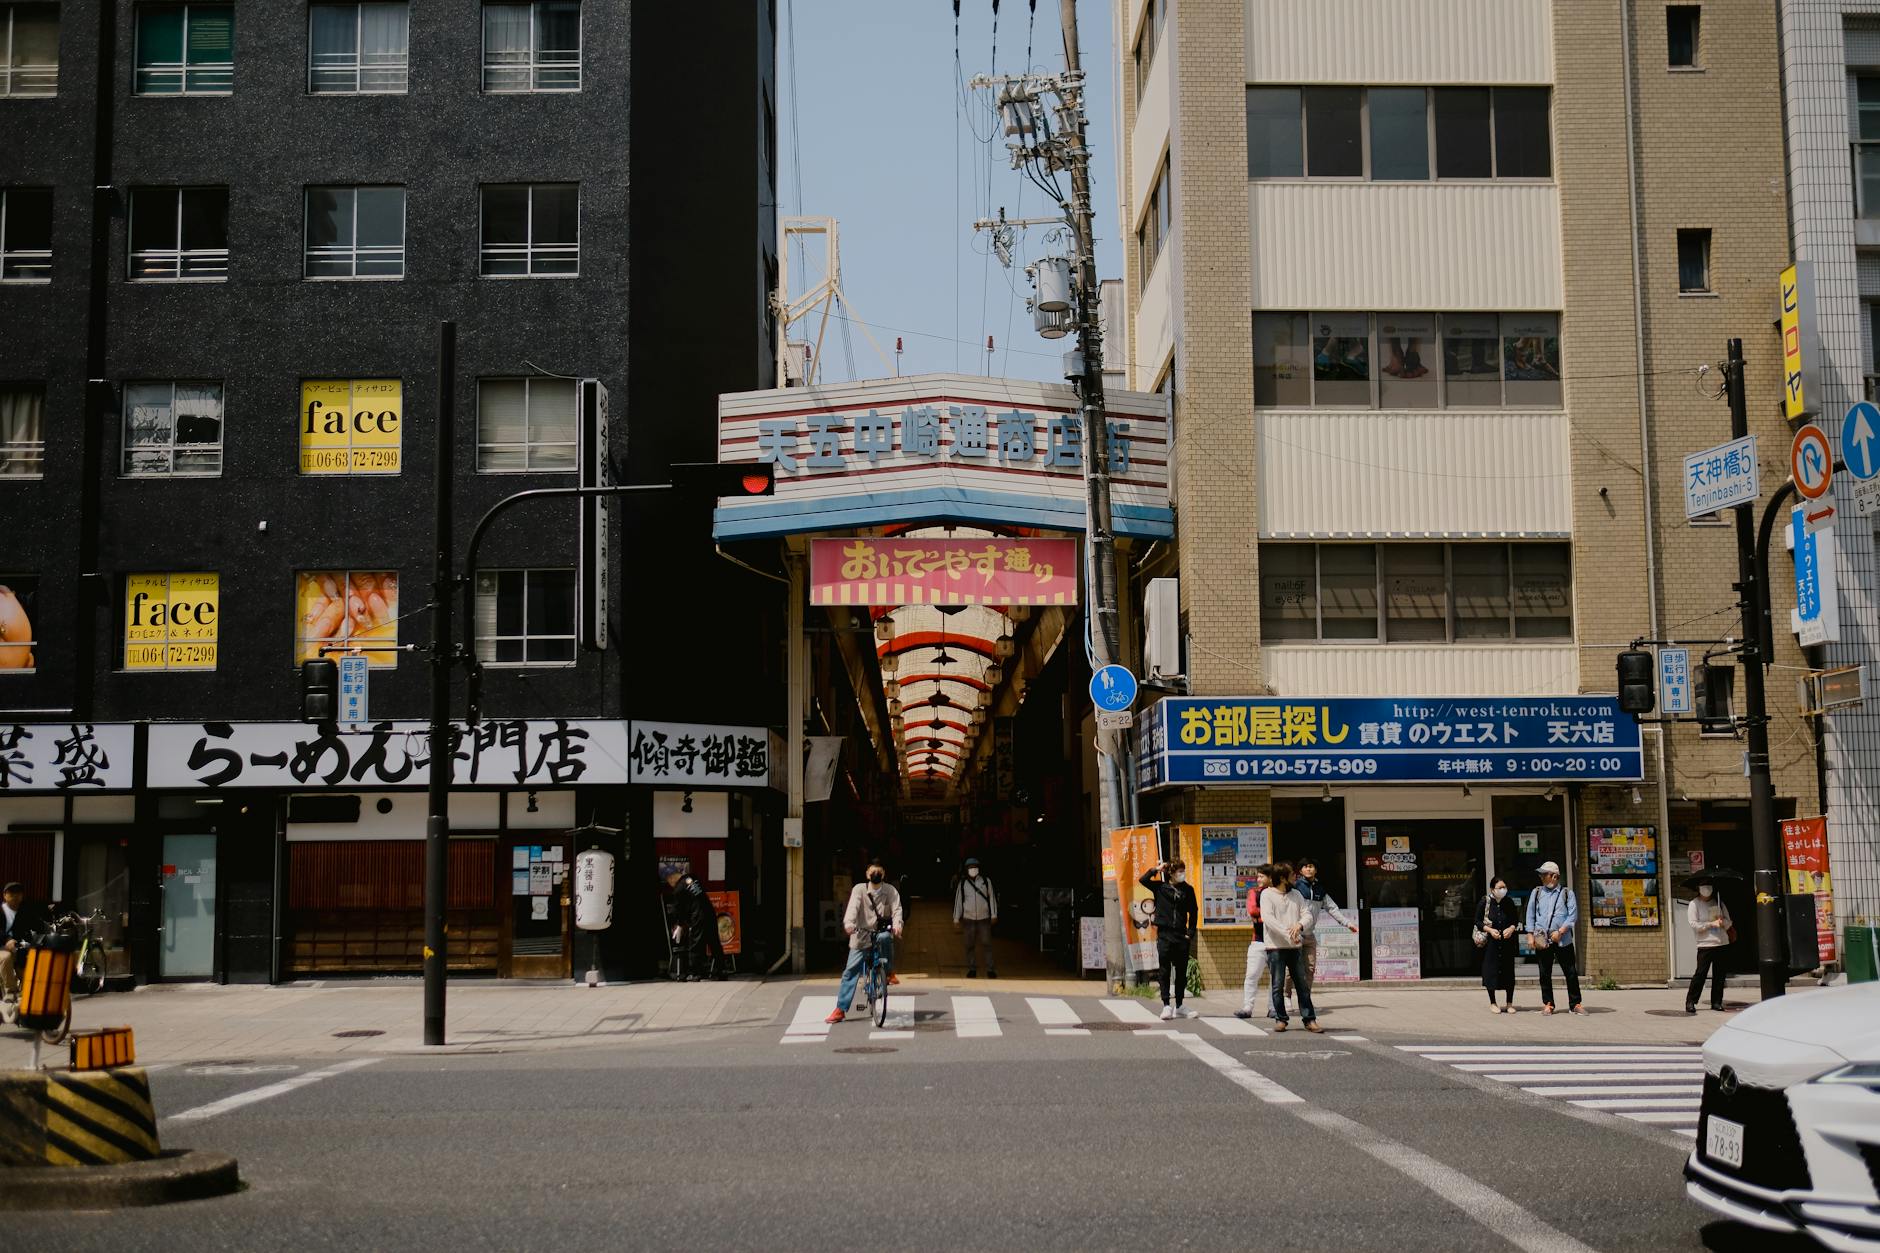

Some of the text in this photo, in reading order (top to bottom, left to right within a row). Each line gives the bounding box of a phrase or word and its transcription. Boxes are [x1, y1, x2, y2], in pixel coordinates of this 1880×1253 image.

[303, 400, 400, 434] face
[1690, 445, 1752, 490] 天神橋5
[1691, 476, 1753, 507] Tenjinbashi-5
[841, 541, 1054, 586] おいでやす通り
[130, 592, 217, 626] face
[343, 661, 353, 694] 自転車
[354, 661, 365, 695] 歩行者
[1663, 654, 1674, 685] 自転車
[1674, 653, 1686, 685] 歩行者
[349, 697, 358, 719] 専用
[1394, 703, 1613, 720] http://west-tenroku.com
[1671, 687, 1681, 708] 専用
[1180, 705, 1350, 747] お部屋探し
[1547, 720, 1615, 744] 天六店
[1235, 758, 1378, 776] 0120-575-909
[1437, 758, 1494, 772] 年中無休
[1783, 824, 1810, 836] 住まい
[1786, 837, 1825, 850] さがしは、
[532, 866, 551, 875] 学割
[1788, 854, 1821, 865] 当店へ。
